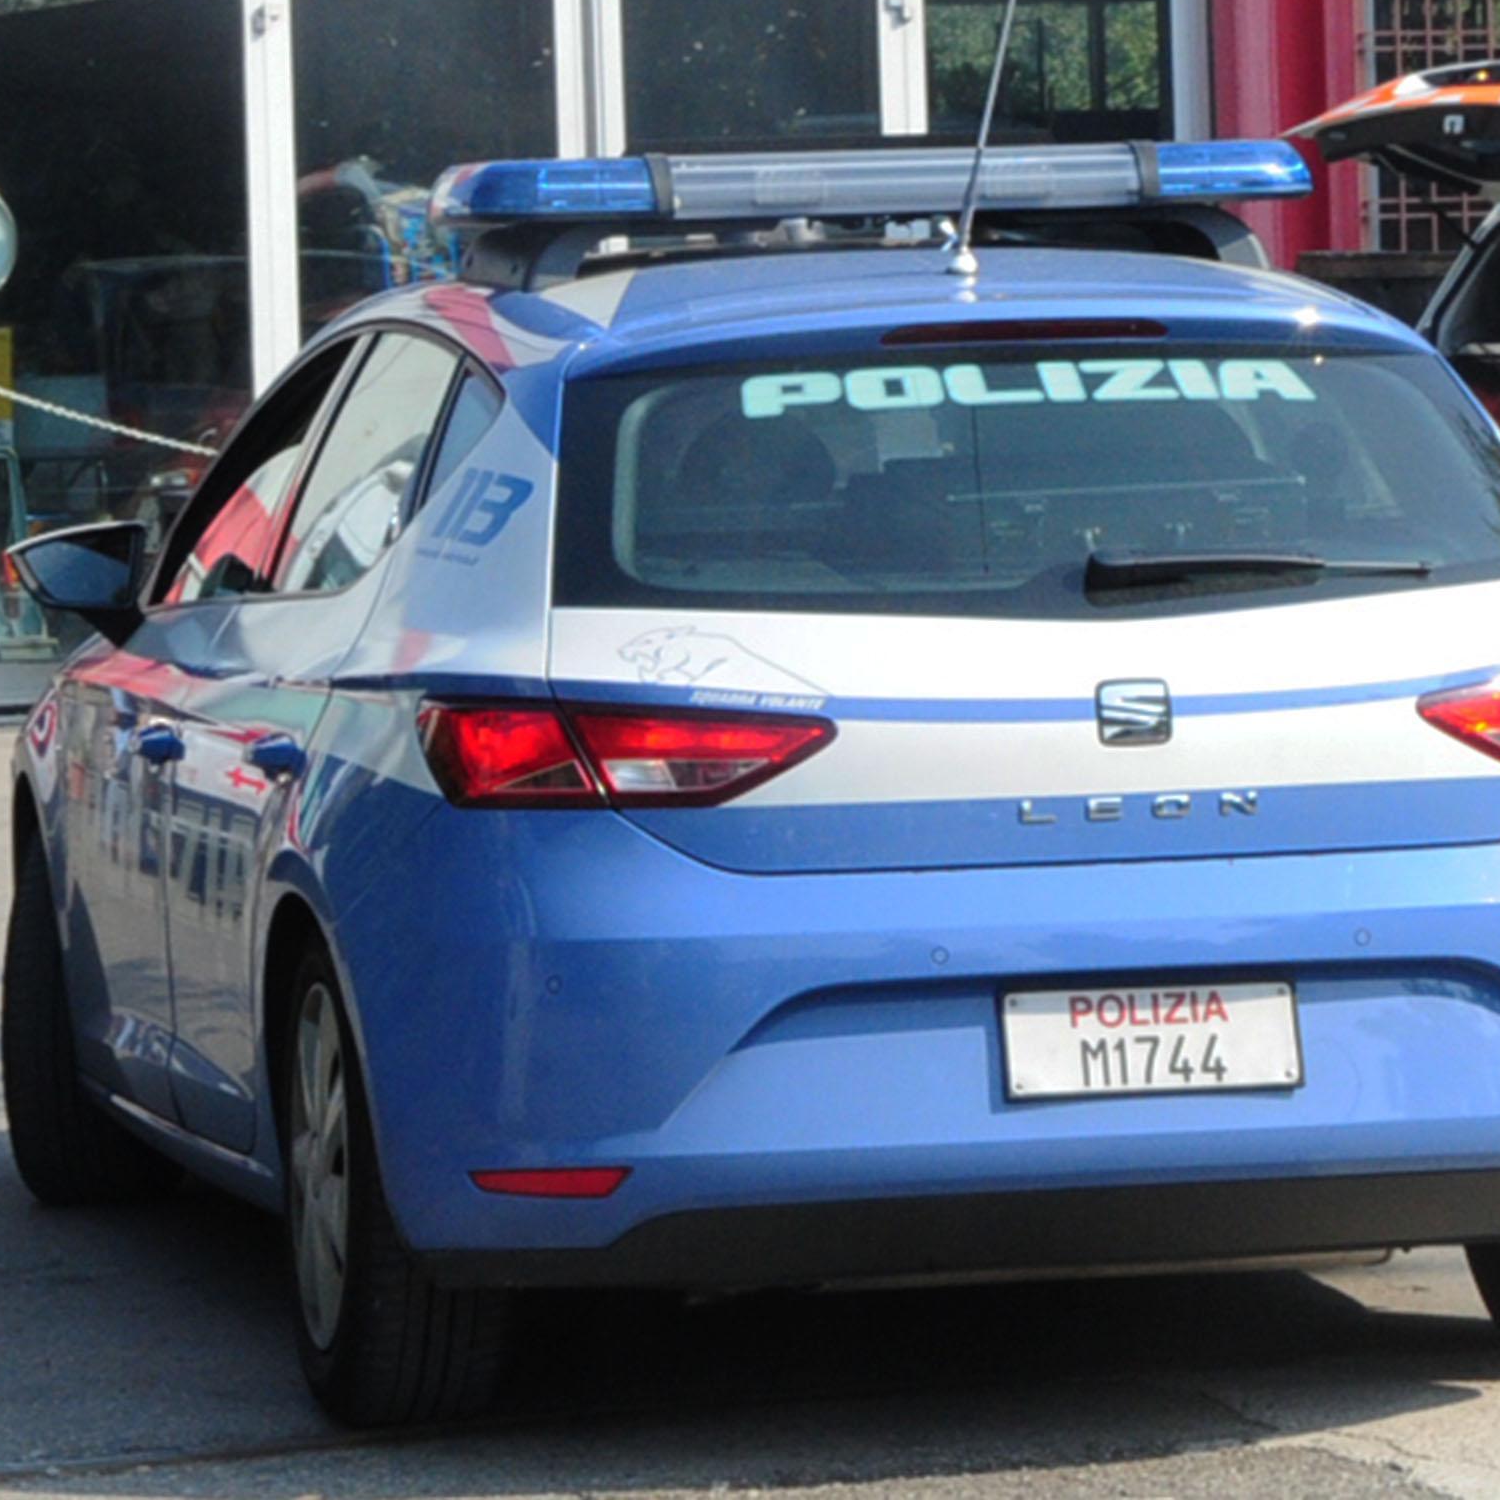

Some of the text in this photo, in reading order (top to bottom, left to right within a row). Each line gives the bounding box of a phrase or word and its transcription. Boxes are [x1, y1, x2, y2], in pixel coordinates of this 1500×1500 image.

[740, 360, 1317, 419] POLIZIA
[1018, 790, 1257, 824] LEON
[1068, 990, 1229, 1028] POLIZIA
[1080, 1033, 1228, 1087] M1744
